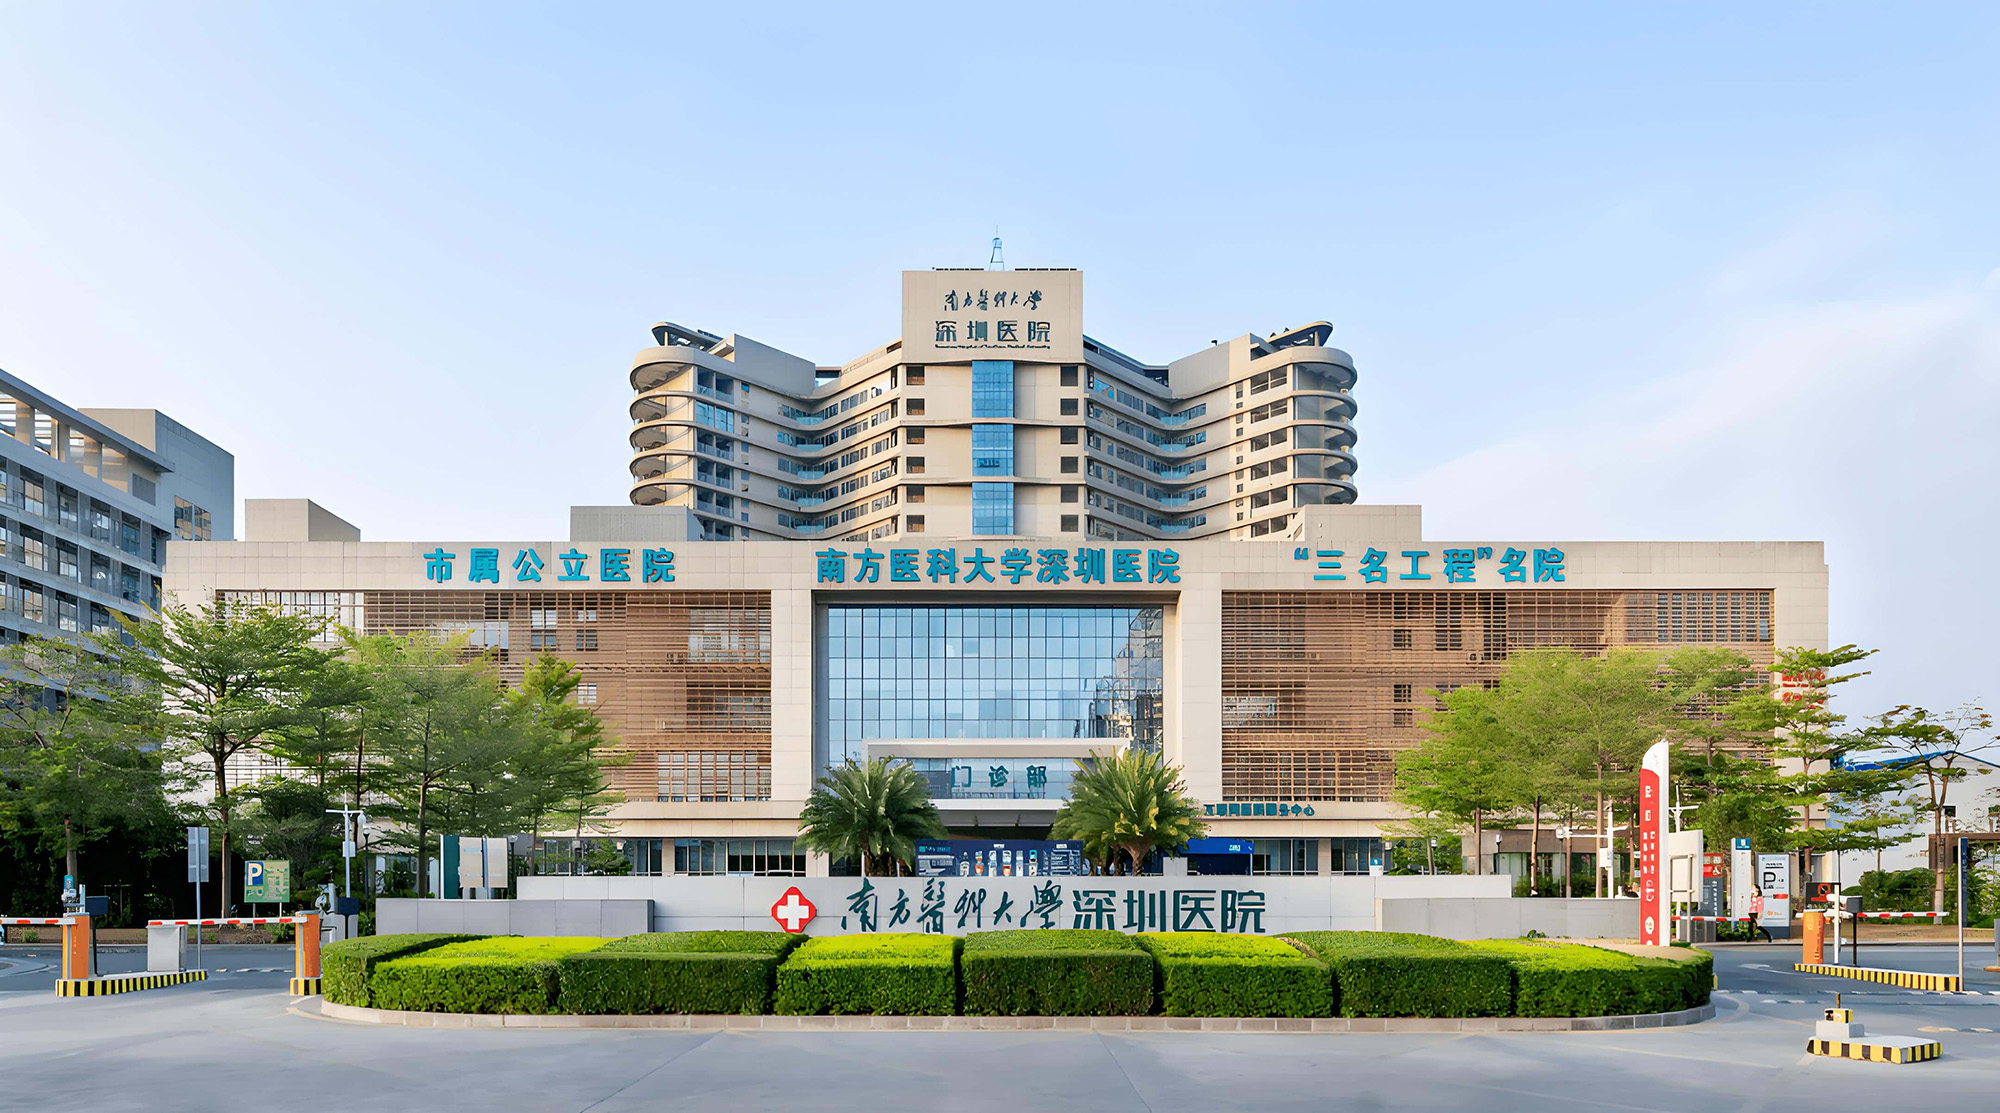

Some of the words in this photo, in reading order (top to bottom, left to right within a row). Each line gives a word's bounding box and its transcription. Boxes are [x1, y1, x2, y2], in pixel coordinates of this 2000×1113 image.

[935, 320, 1050, 342] 深圳医院
[423, 547, 675, 583] 市属公立医院
[815, 547, 1182, 584] 南方医科大学深圳医院
[248, 863, 263, 886] P
